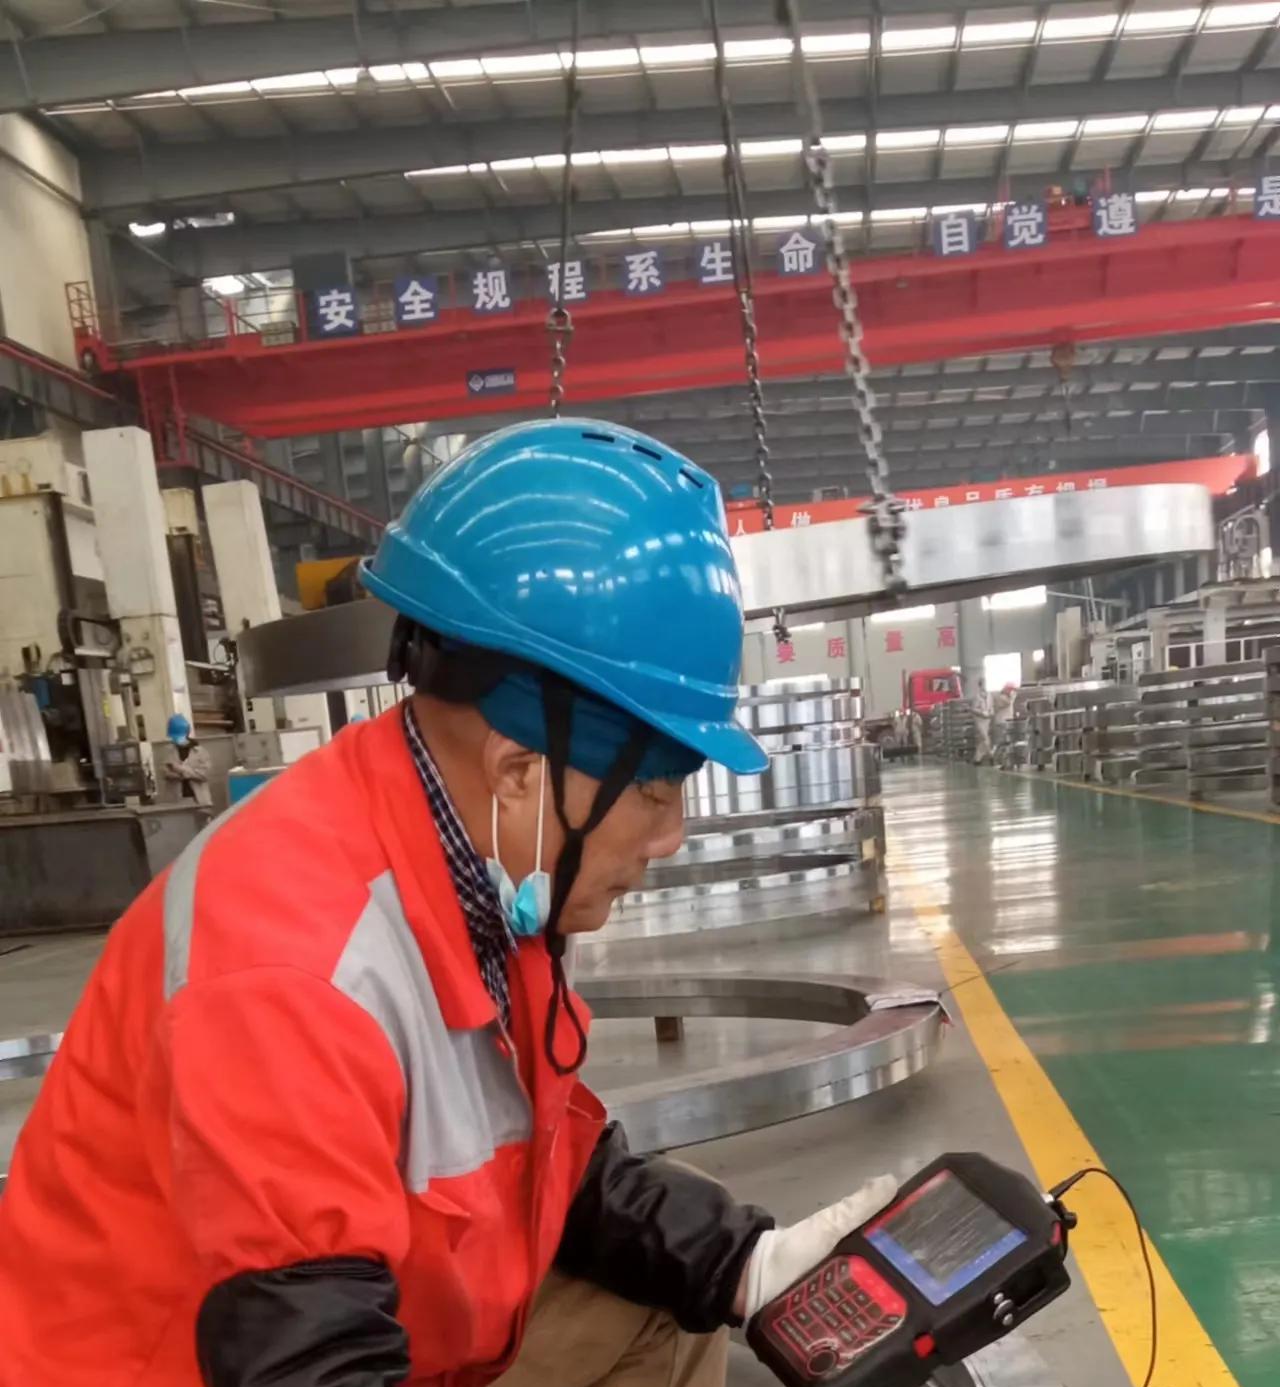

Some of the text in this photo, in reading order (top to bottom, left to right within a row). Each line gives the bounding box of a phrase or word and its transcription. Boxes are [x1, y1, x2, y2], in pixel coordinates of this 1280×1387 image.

[319, 231, 816, 331] 安全规程系生命
